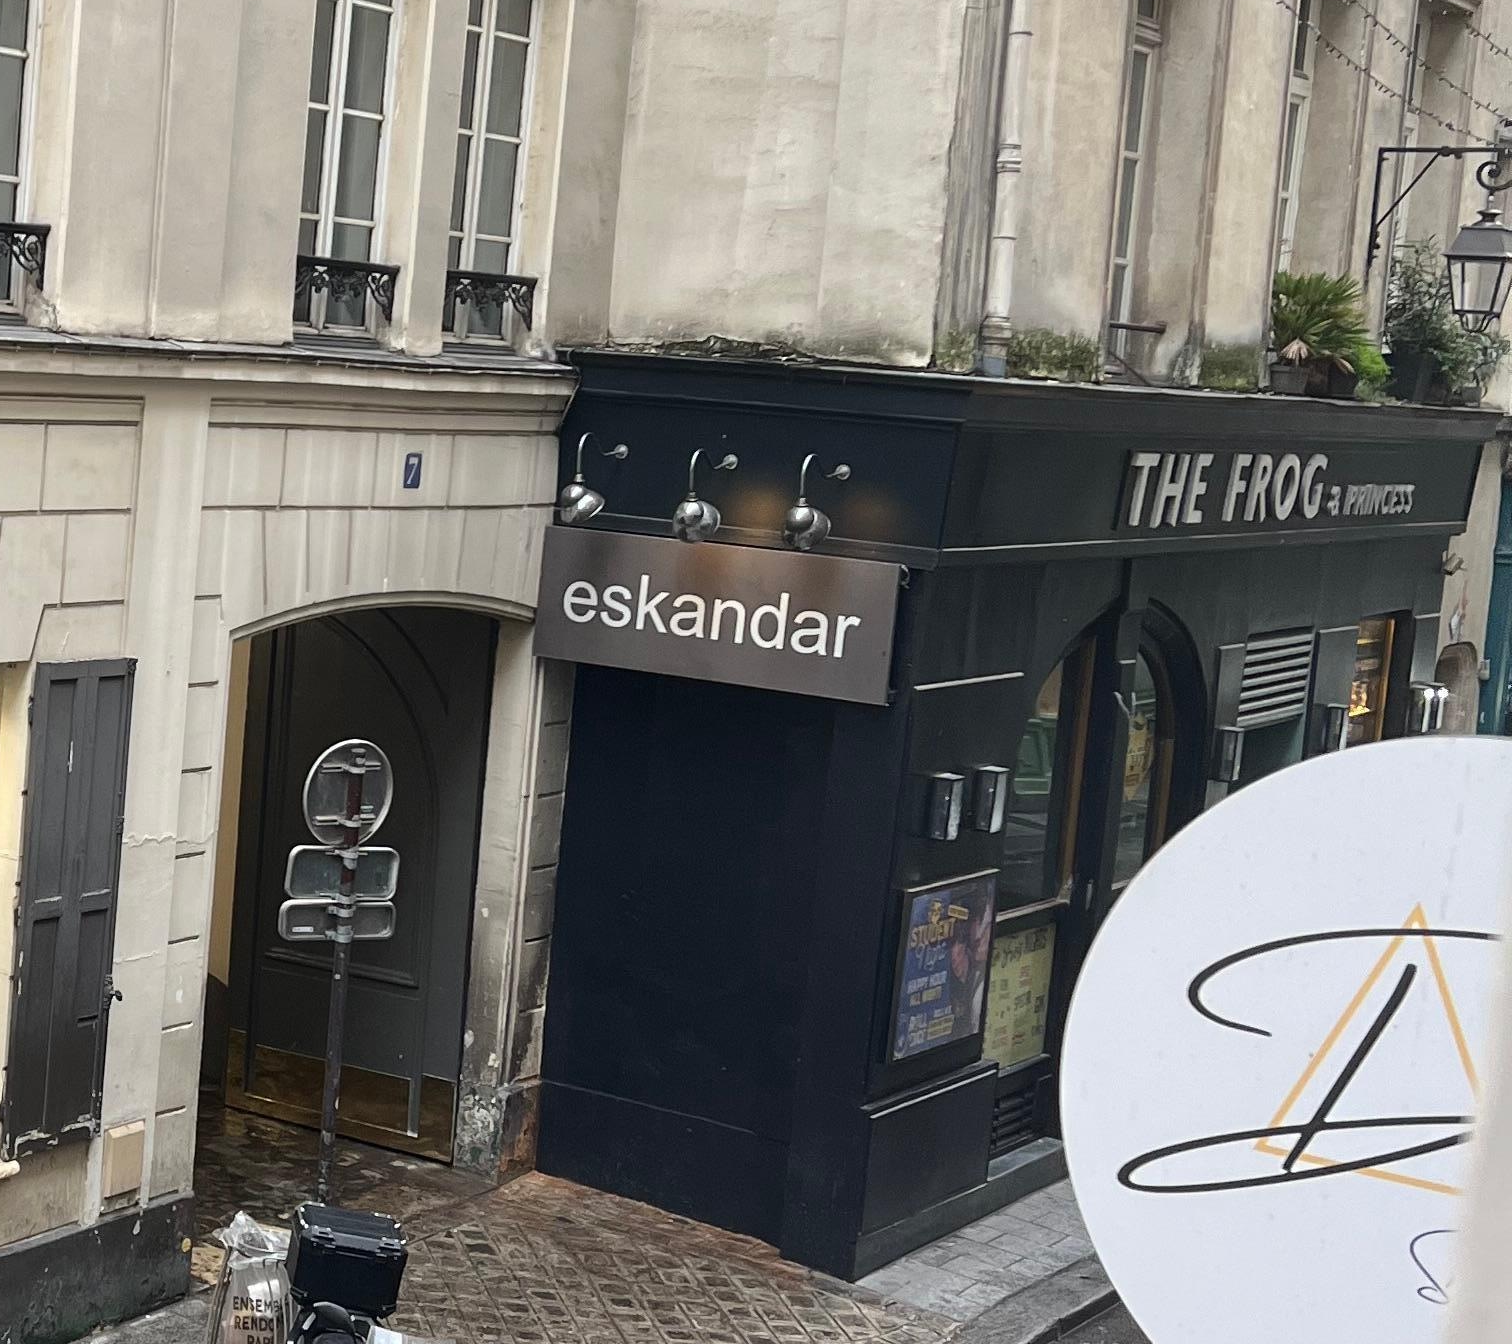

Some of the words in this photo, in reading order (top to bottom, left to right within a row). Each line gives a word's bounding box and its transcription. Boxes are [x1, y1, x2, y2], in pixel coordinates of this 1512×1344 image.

[407, 457, 419, 485] 7
[1128, 453, 1214, 529] THE
[1221, 453, 1329, 524] FROG
[1343, 483, 1416, 516] PRINCESS
[562, 574, 862, 658] eskandar
